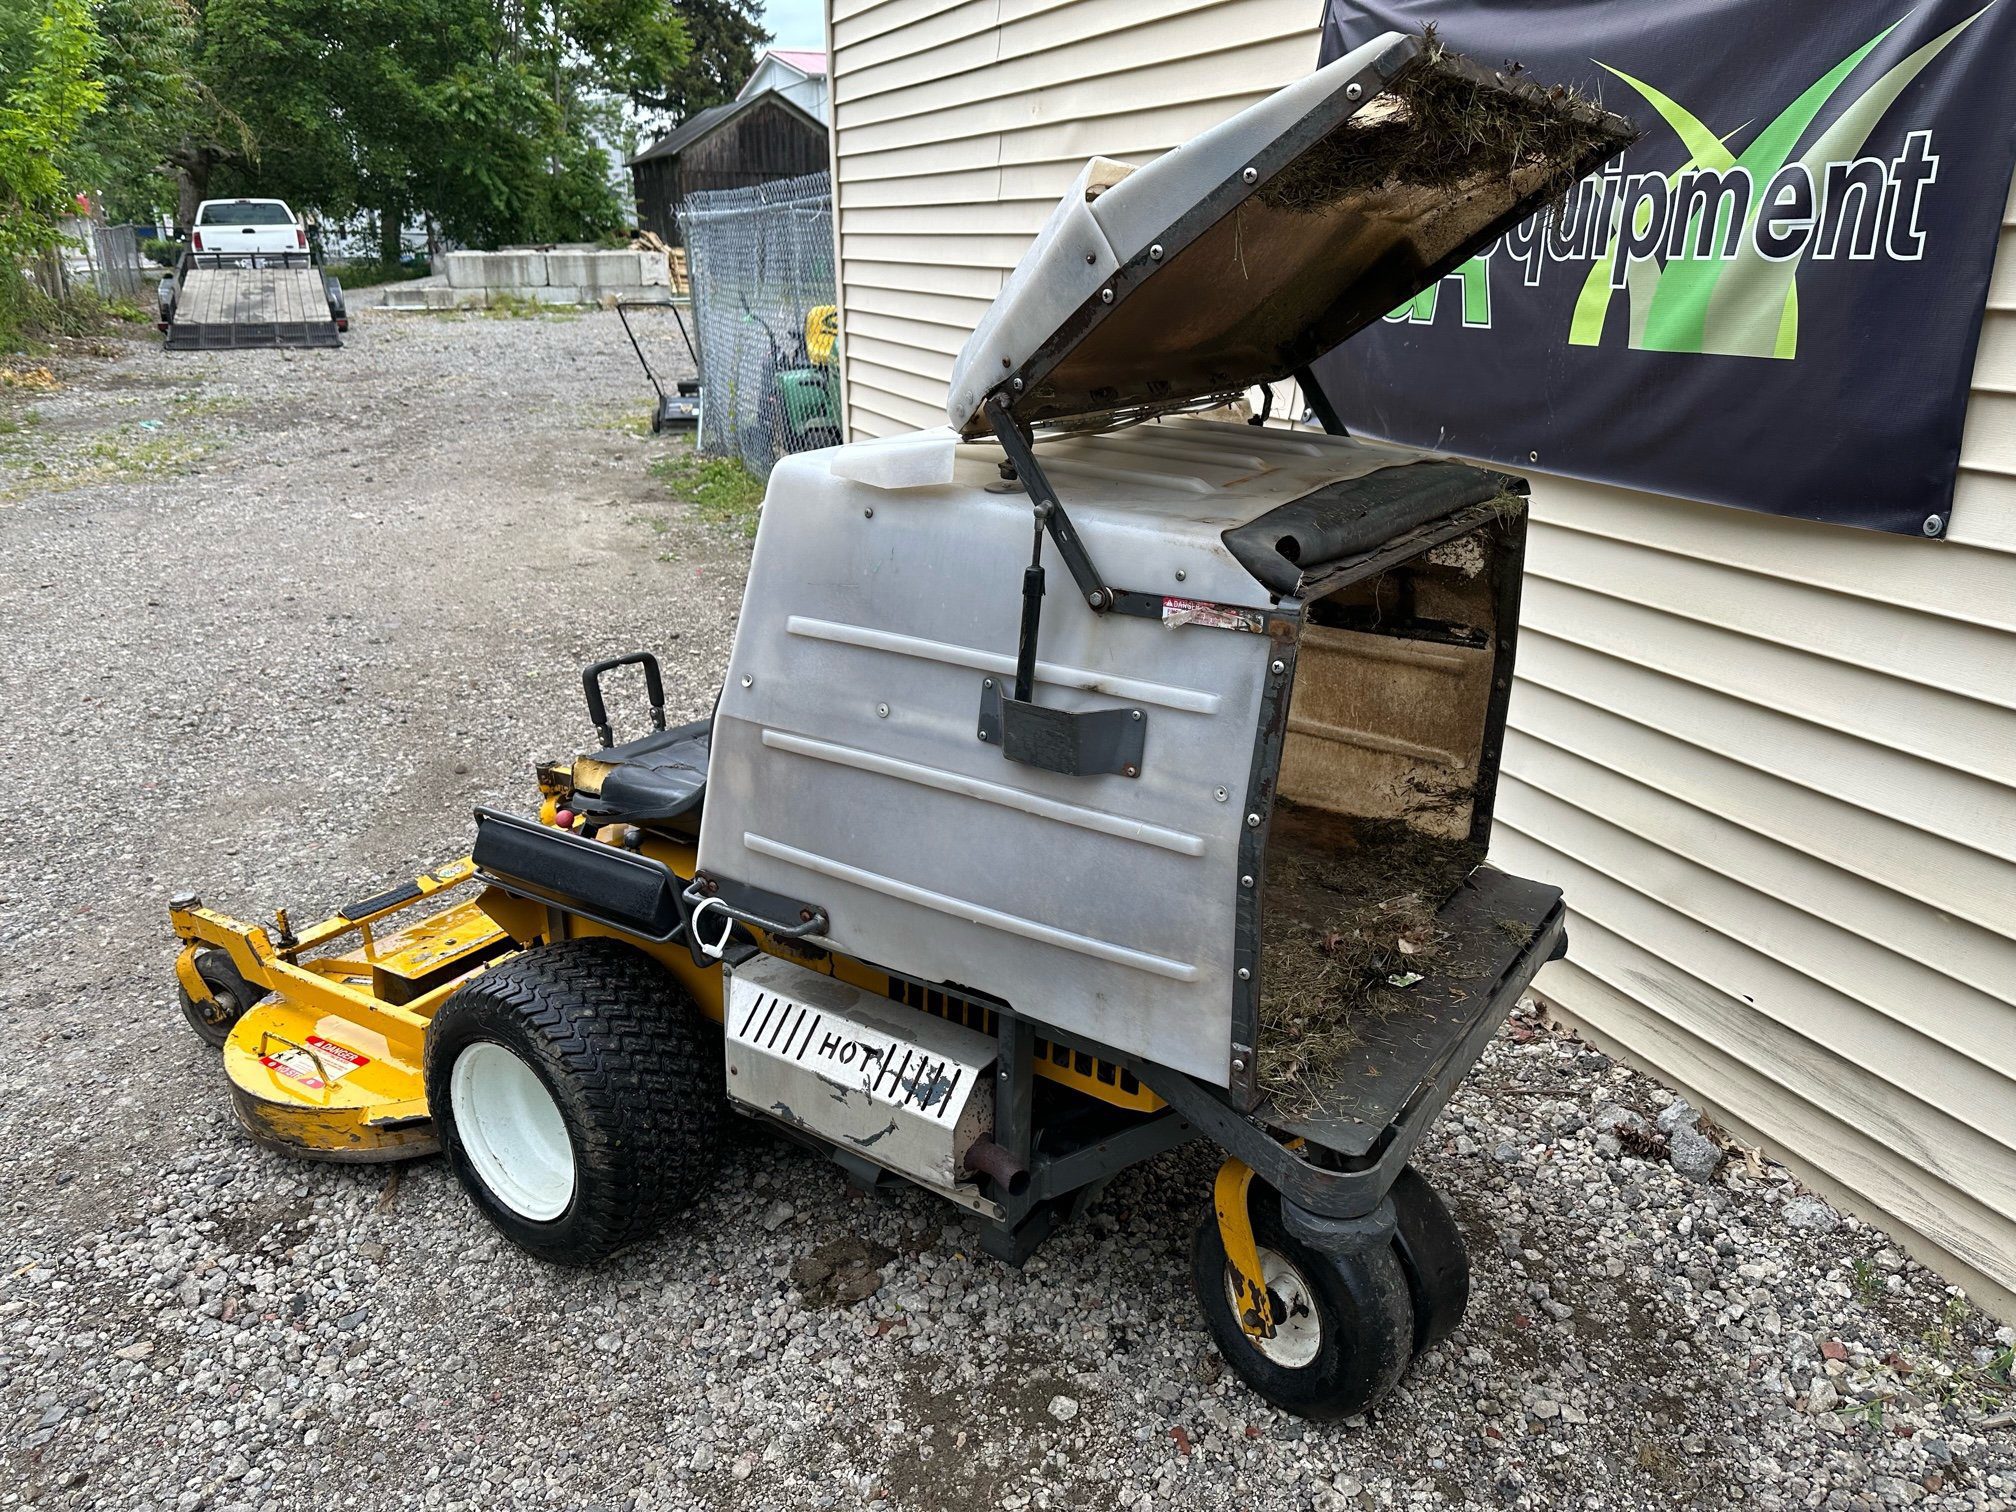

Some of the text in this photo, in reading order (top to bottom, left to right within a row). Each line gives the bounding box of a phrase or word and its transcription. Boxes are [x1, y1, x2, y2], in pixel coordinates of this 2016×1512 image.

[1473, 130, 1940, 290] quipment
[323, 1043, 358, 1061] DANGER
[817, 1032, 879, 1072] HOT
